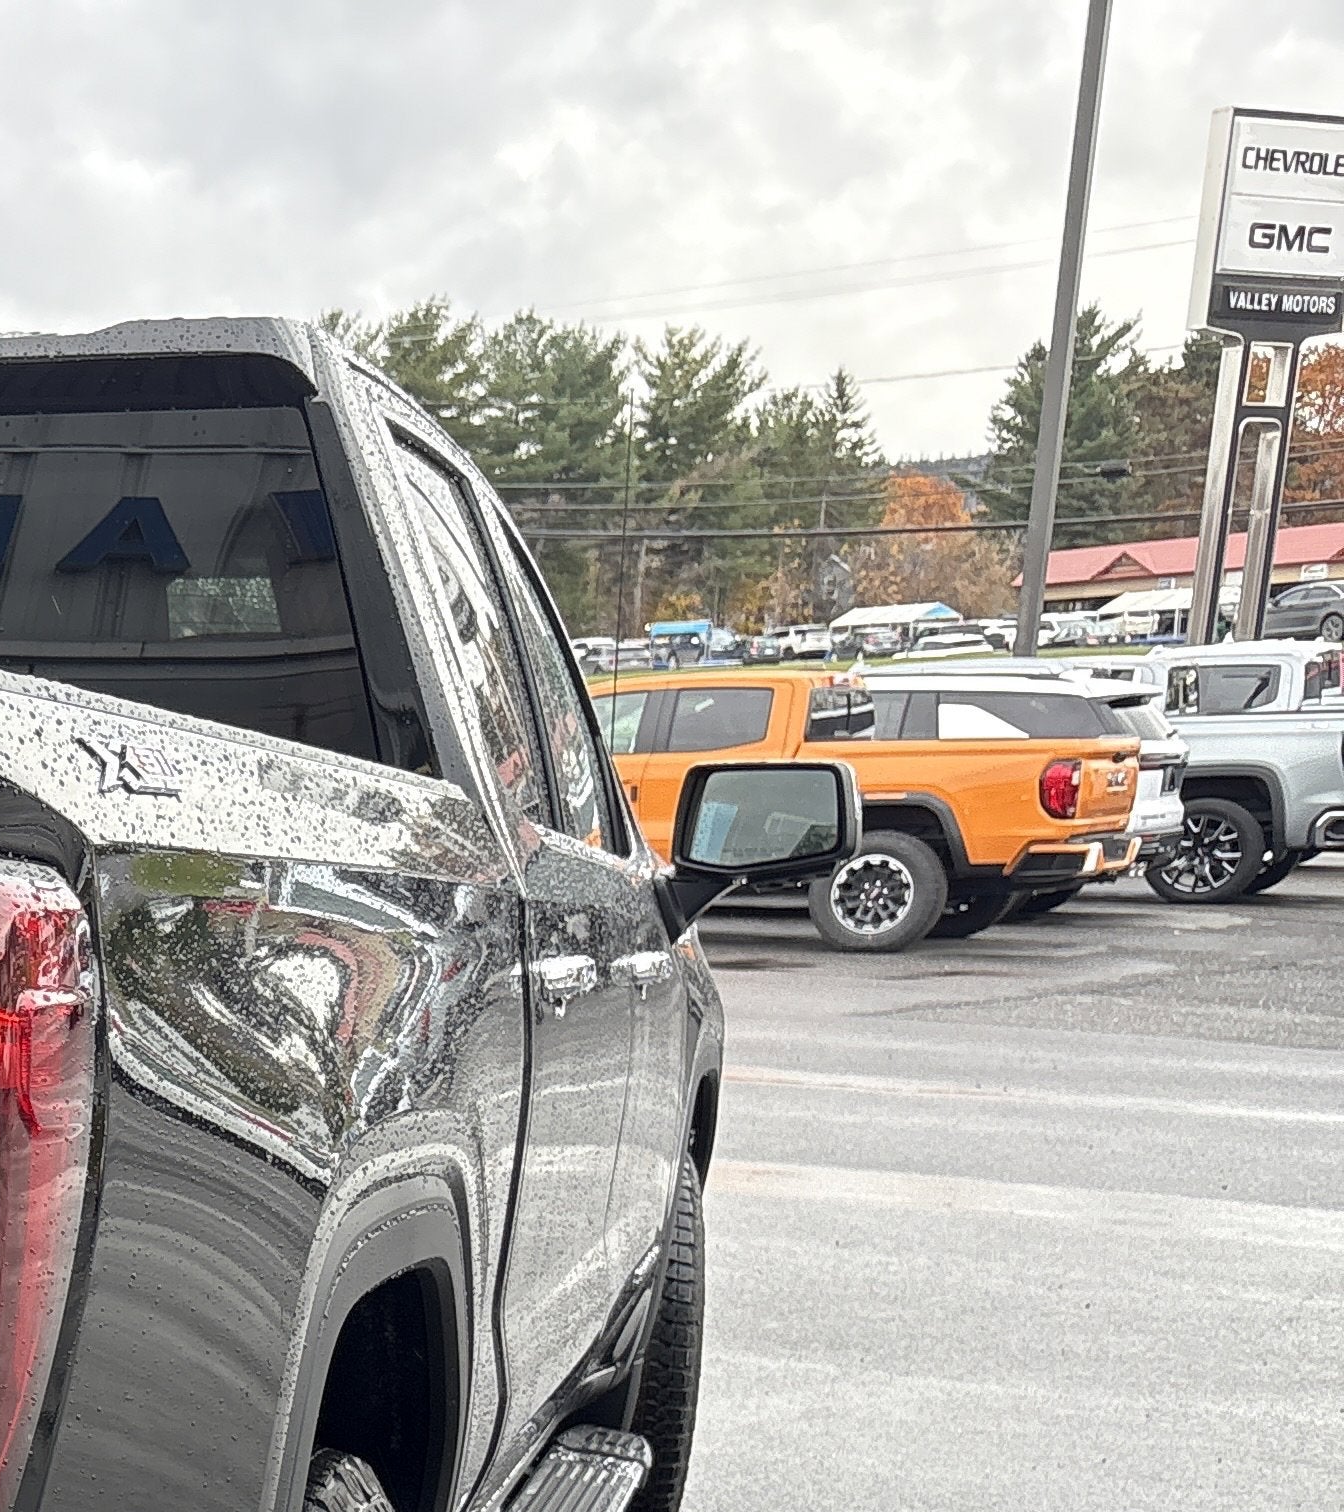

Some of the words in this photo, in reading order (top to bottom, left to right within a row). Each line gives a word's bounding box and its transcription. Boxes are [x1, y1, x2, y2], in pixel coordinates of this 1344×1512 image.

[1248, 222, 1332, 254] GMC
[1229, 290, 1279, 311] VALLEY
[1281, 294, 1336, 315] MOTORS
